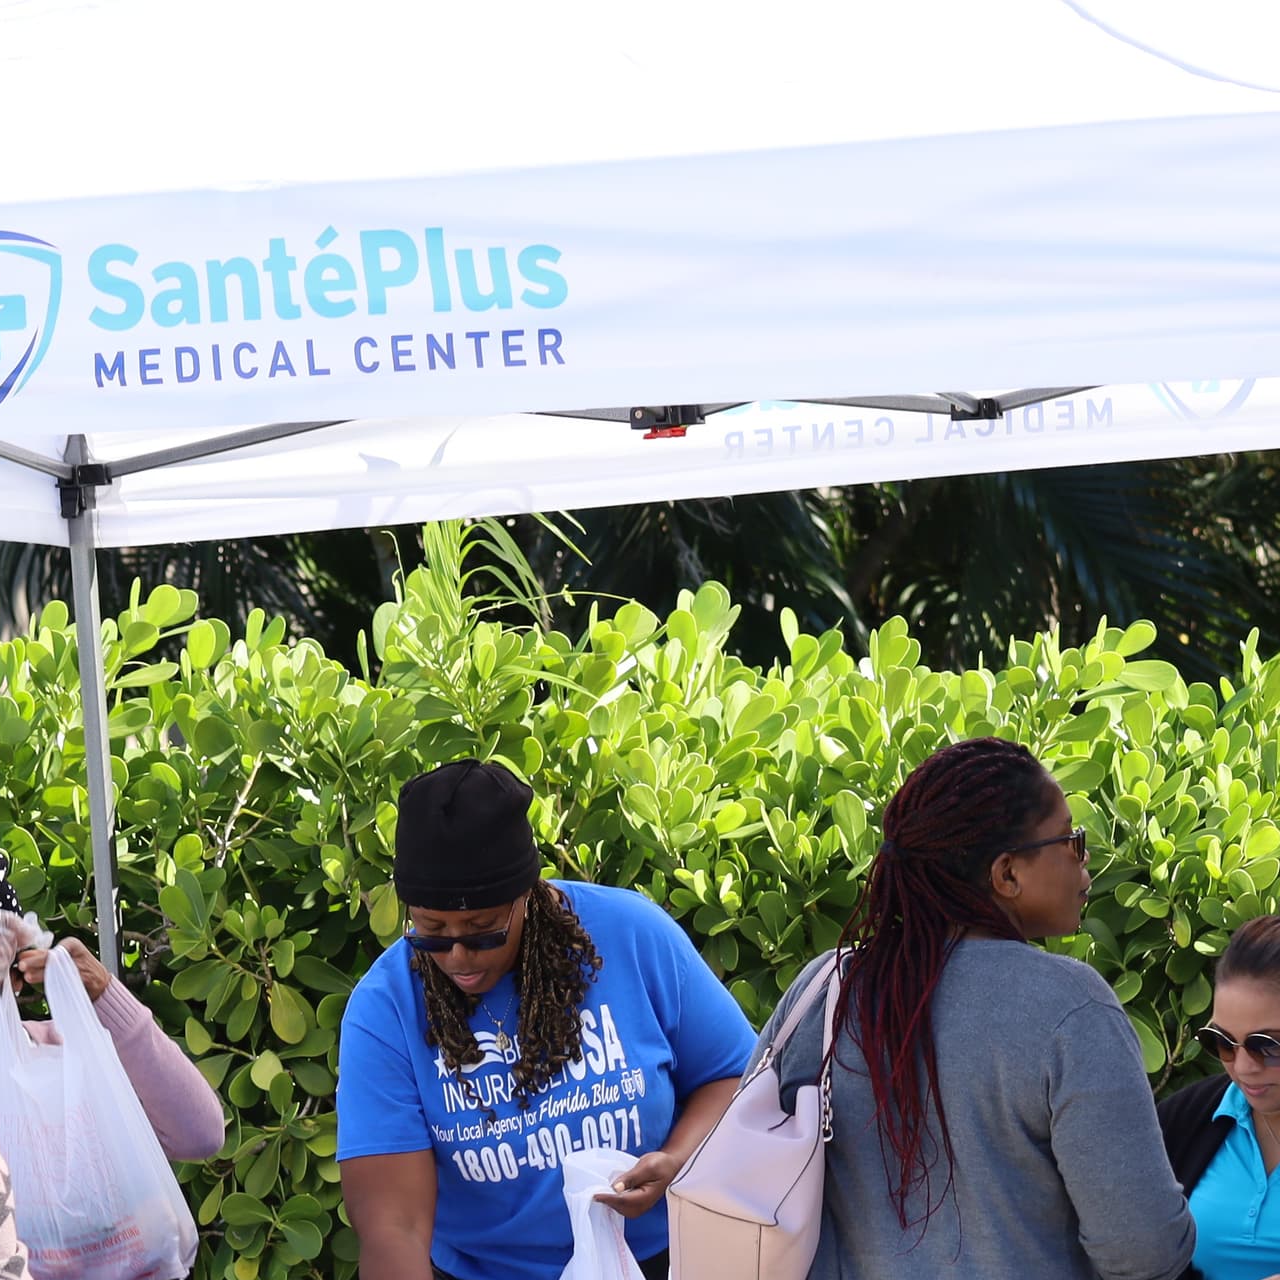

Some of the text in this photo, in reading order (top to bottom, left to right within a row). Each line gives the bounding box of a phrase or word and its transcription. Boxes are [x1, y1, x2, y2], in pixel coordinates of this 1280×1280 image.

[88, 225, 569, 331] SantéPlus
[94, 328, 567, 388] MEDICAL CENTER
[432, 1078, 620, 1143] Your Local Agency for Florida Blue
[452, 1104, 643, 1183] 1800-490-0971
